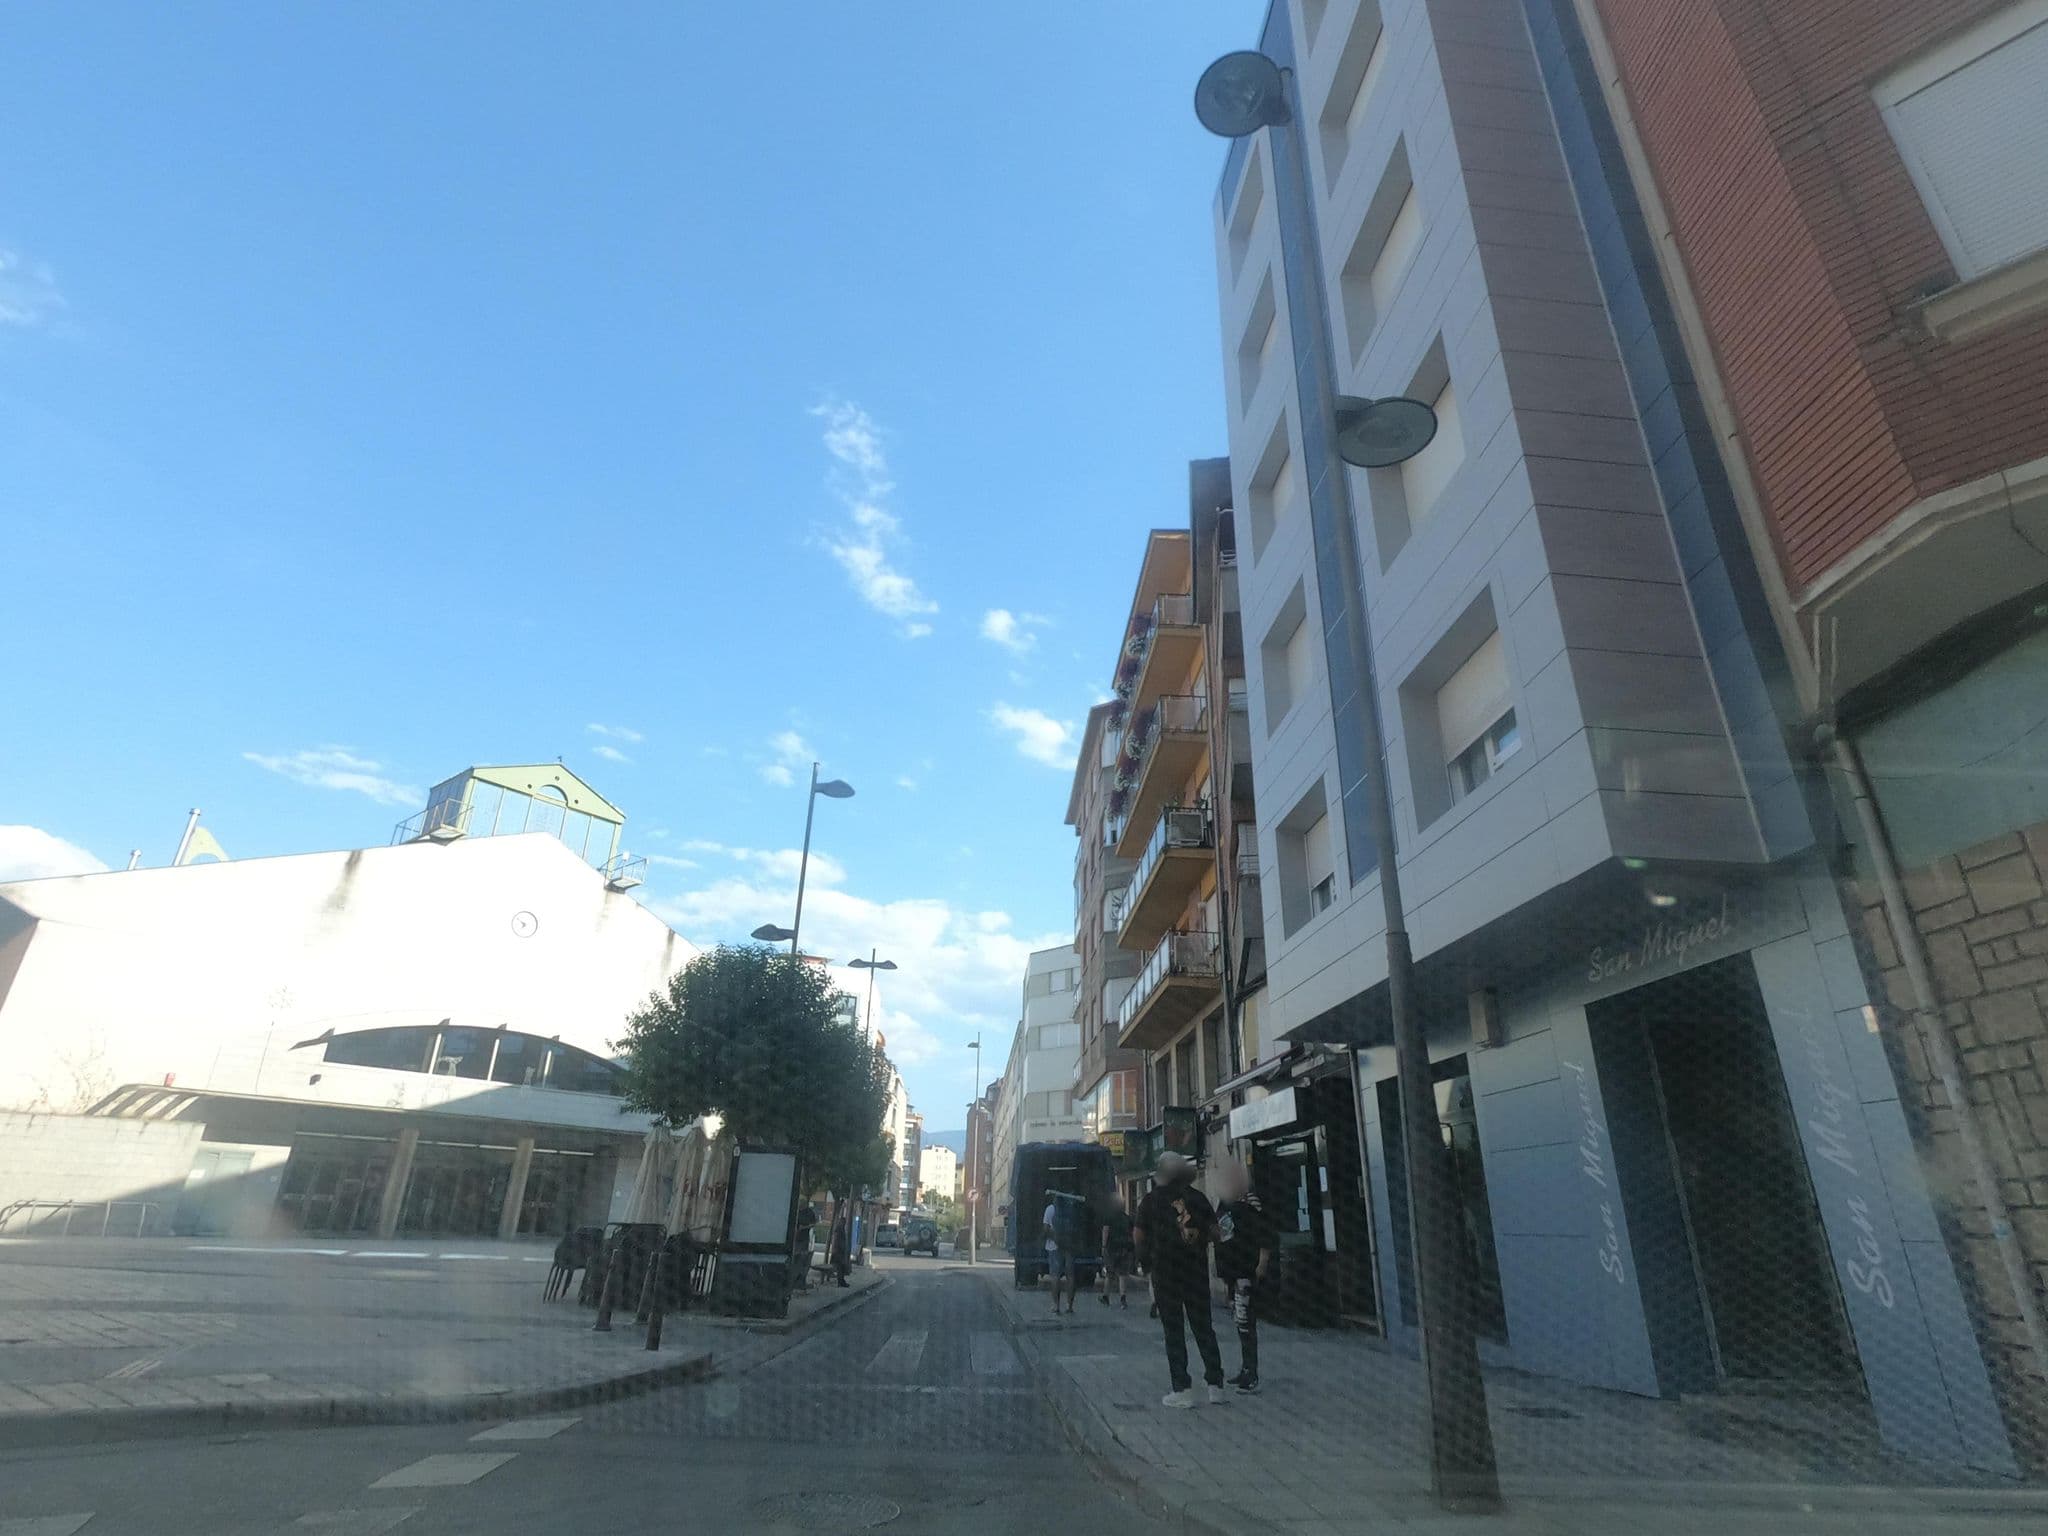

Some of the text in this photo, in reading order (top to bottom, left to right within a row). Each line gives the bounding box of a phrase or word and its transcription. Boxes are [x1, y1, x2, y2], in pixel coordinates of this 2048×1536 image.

[1640, 894, 1732, 968] Miguel
[1599, 1200, 1625, 1284] San
[1848, 1193, 1894, 1309] San
